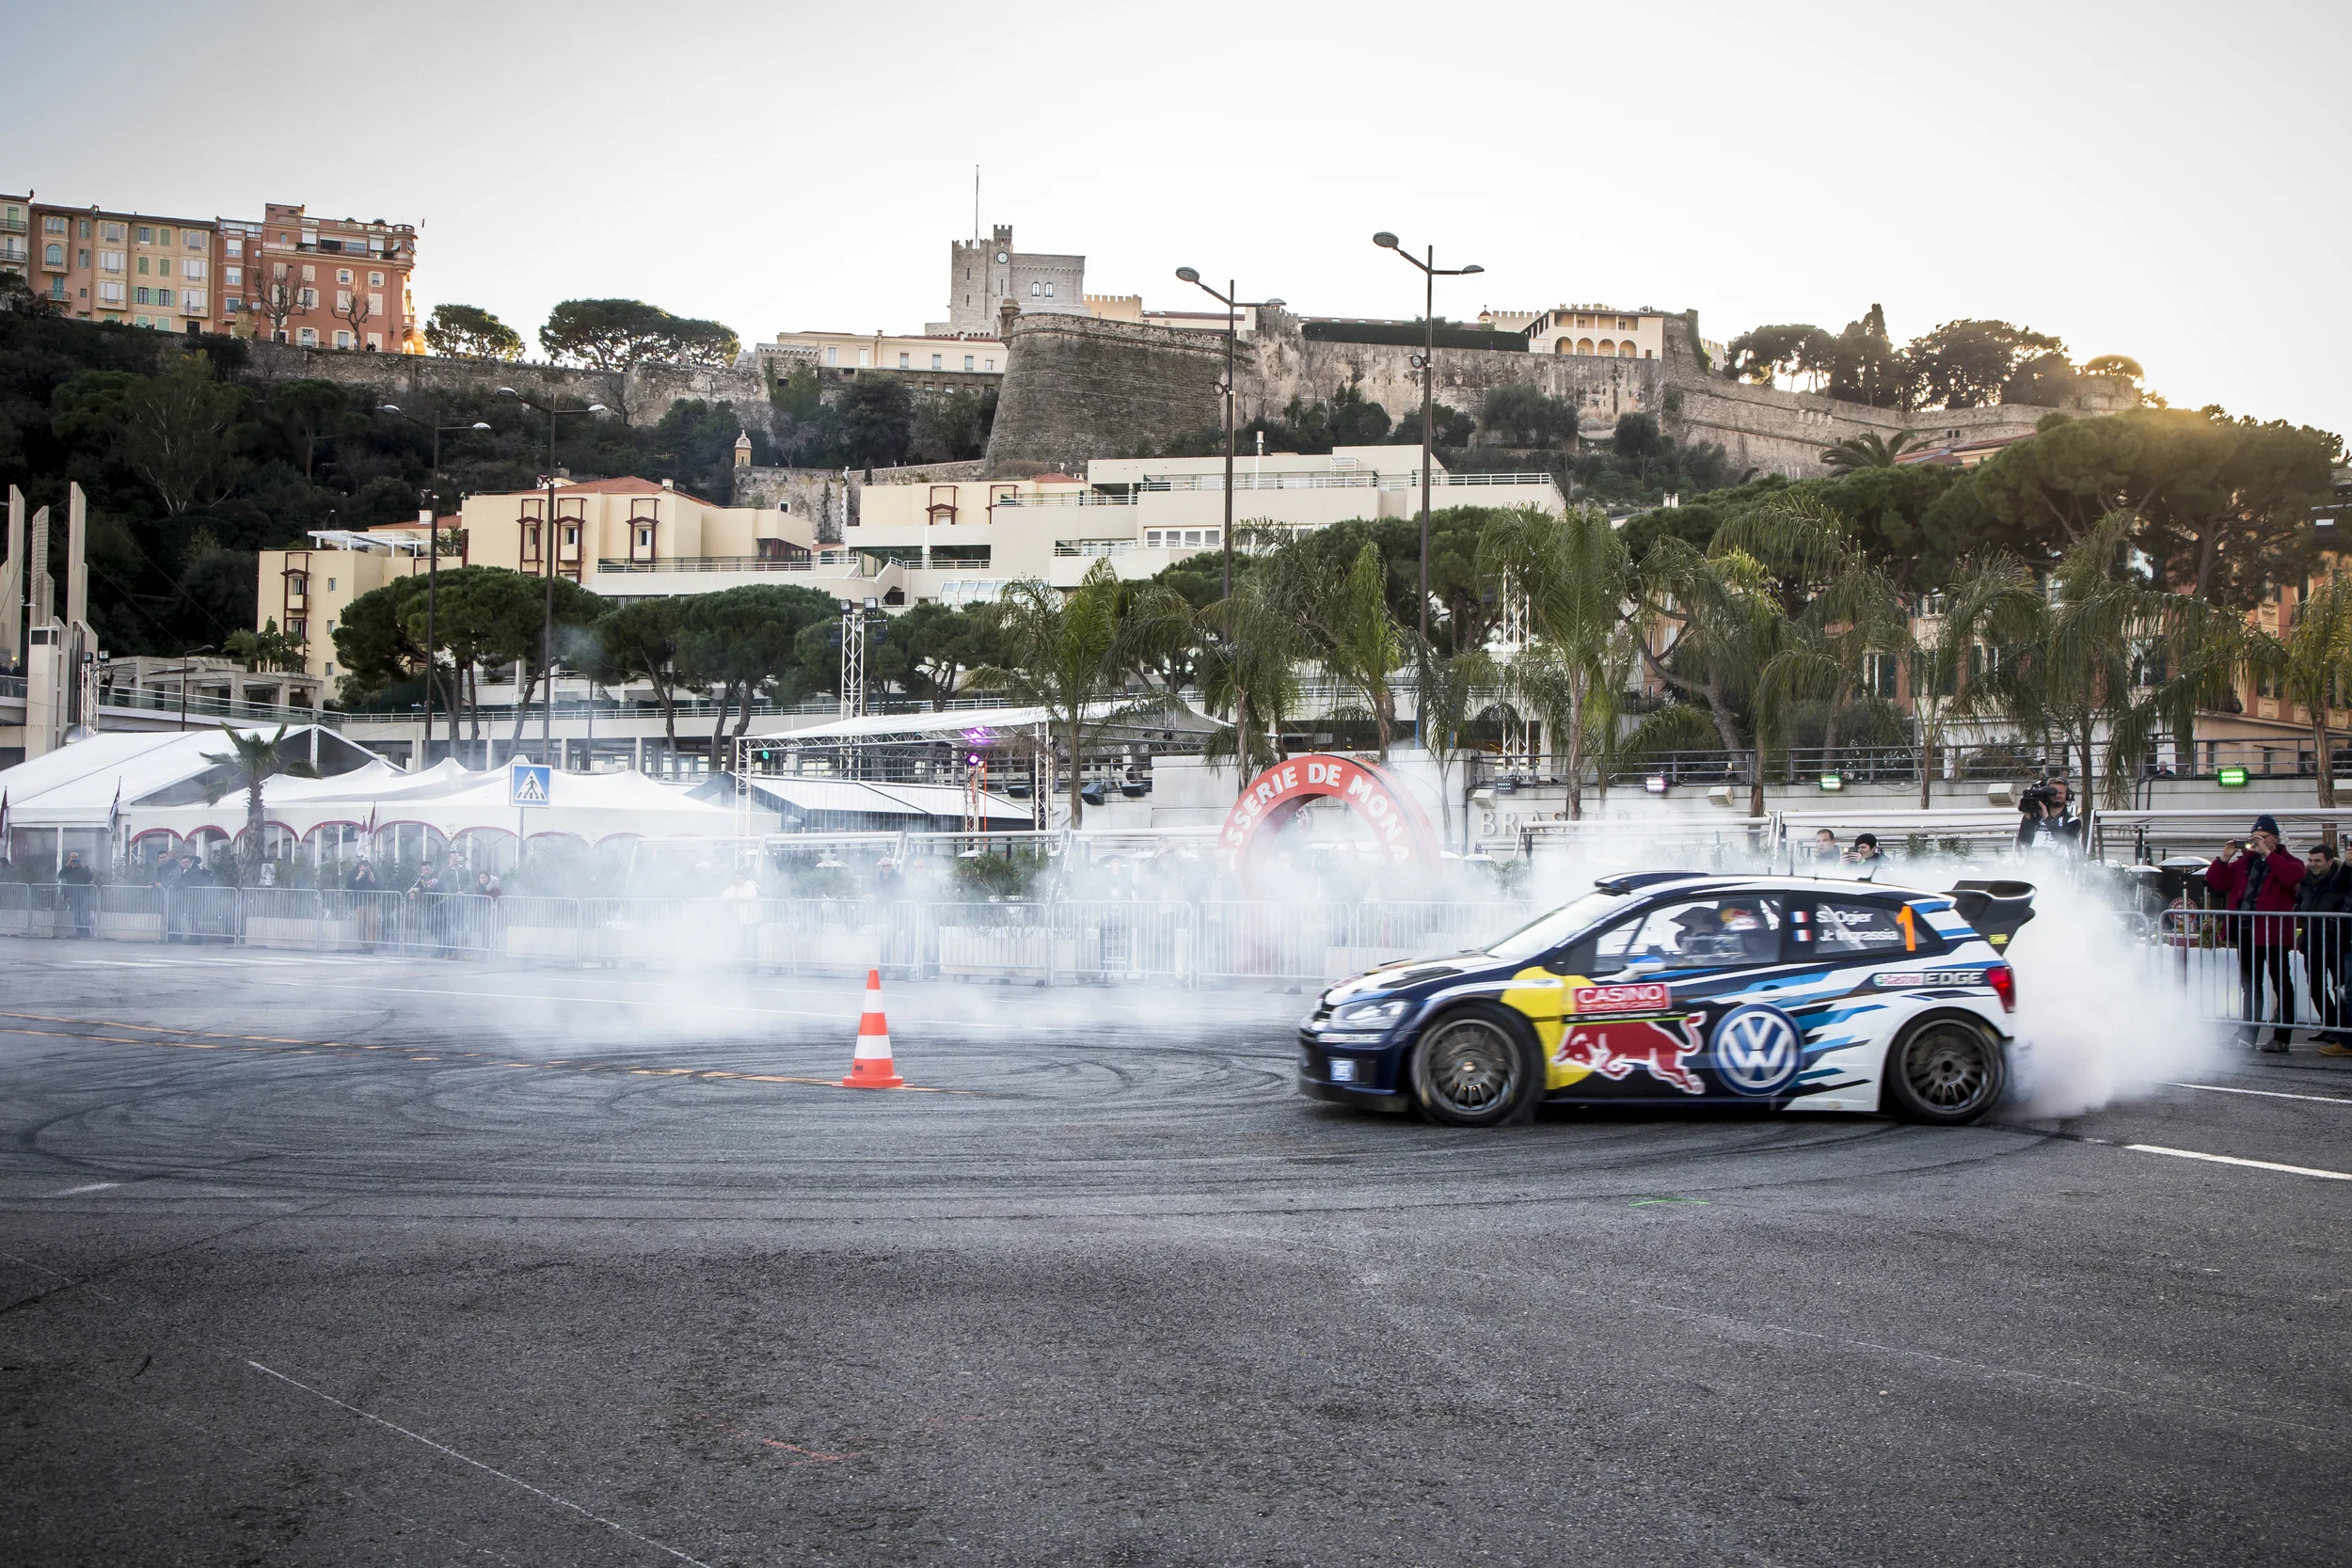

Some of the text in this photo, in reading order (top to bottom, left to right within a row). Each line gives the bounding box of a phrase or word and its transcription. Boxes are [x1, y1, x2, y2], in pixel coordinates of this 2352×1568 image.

[1308, 763, 1342, 786] DE
[1834, 910, 1873, 925] Ogier
[1836, 928, 1899, 943] Ingrassia
[1896, 905, 1916, 951] 1
[1925, 972, 1983, 985] EDGE
[1577, 985, 1664, 1004] CASINO
